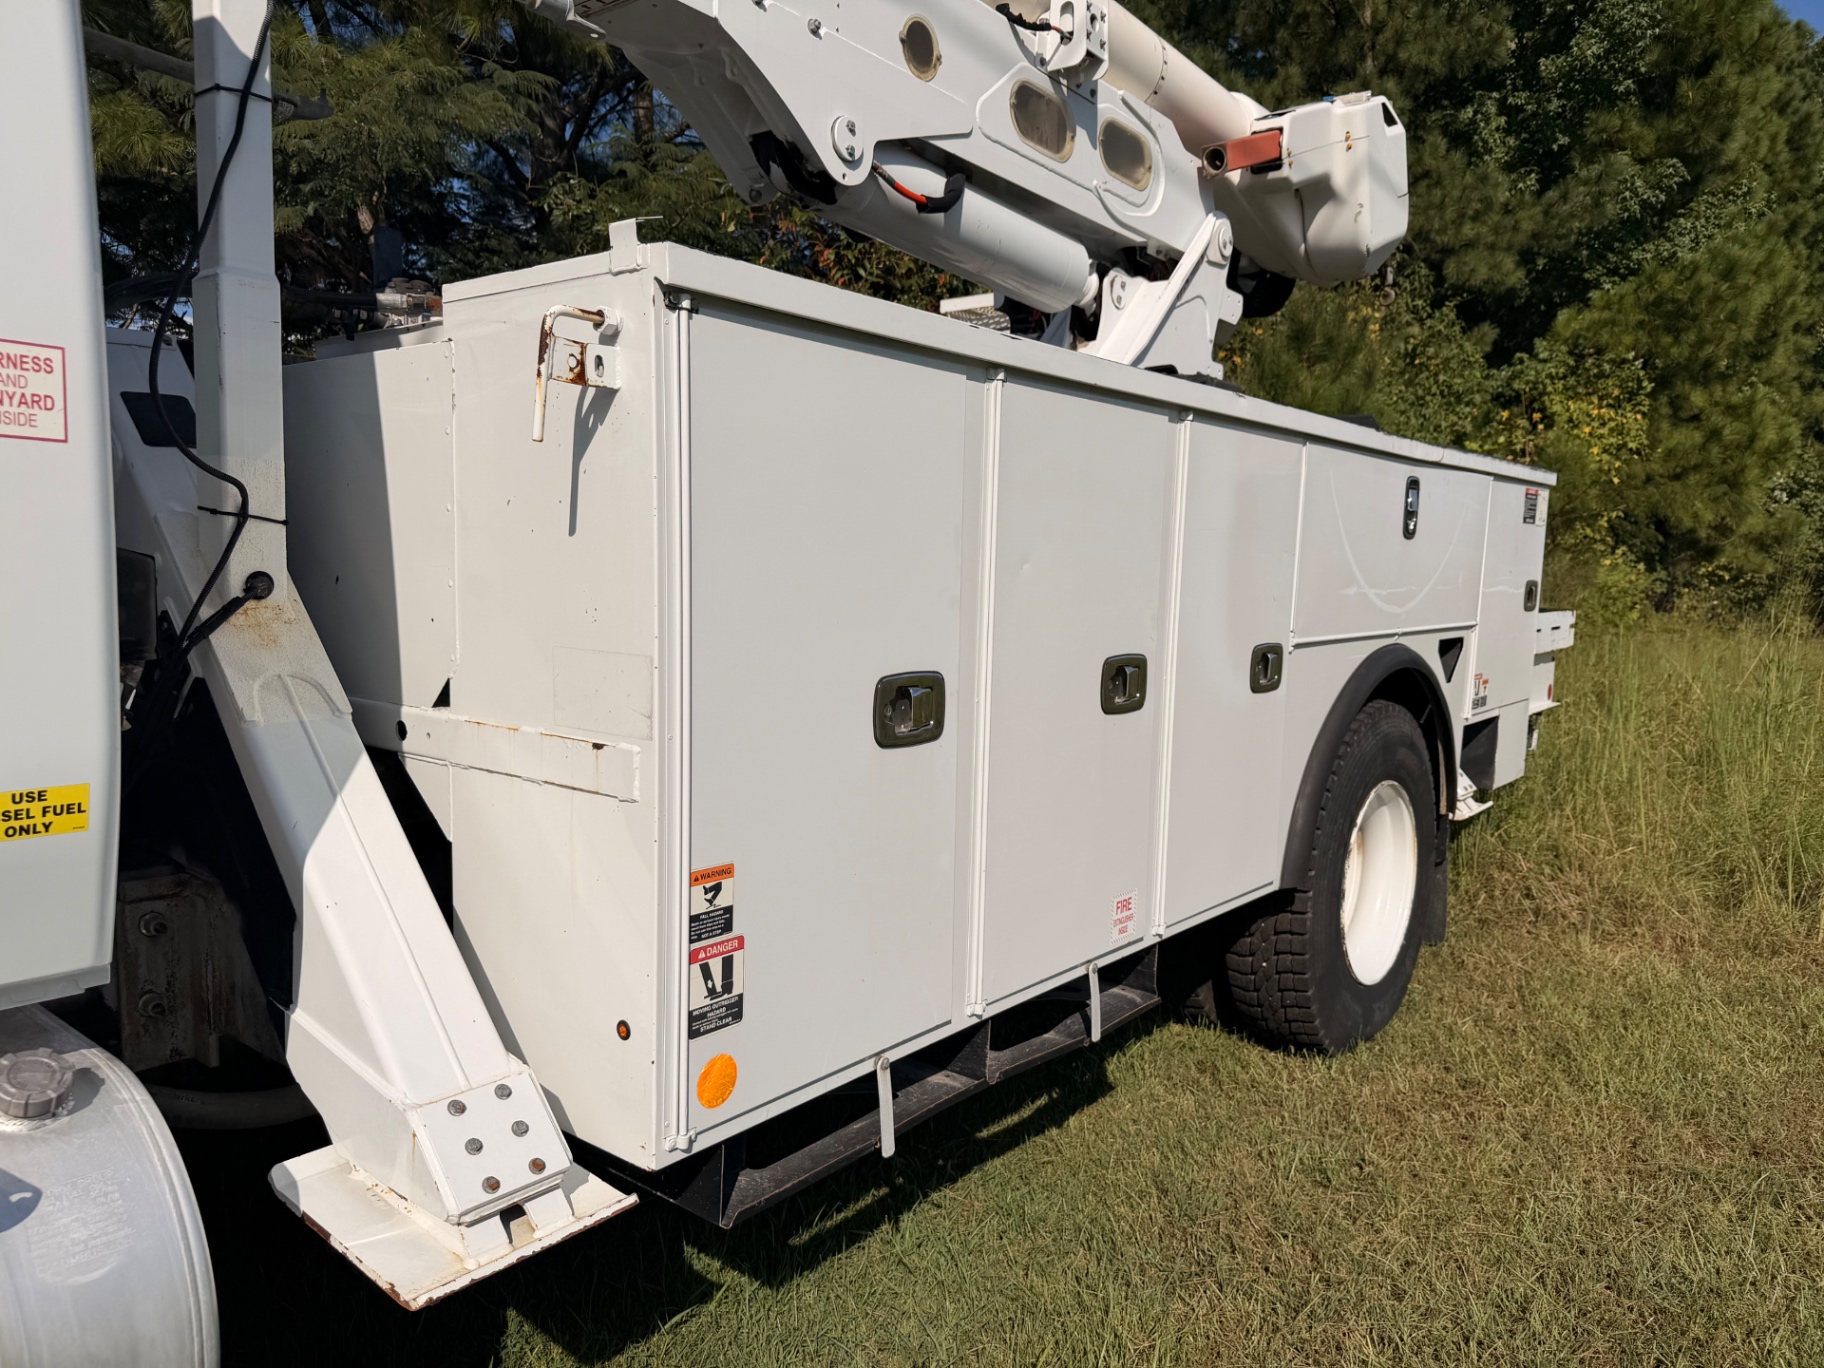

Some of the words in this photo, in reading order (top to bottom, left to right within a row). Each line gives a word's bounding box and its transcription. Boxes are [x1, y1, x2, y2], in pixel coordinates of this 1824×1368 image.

[0, 411, 38, 428] SIDE
[11, 789, 48, 805] USE
[1, 807, 36, 823] SEL
[42, 802, 87, 817] FUEL
[4, 821, 53, 838] ONLY
[700, 867, 732, 881] WARNING
[1116, 897, 1132, 915] FIRE
[706, 939, 739, 957] DANGER
